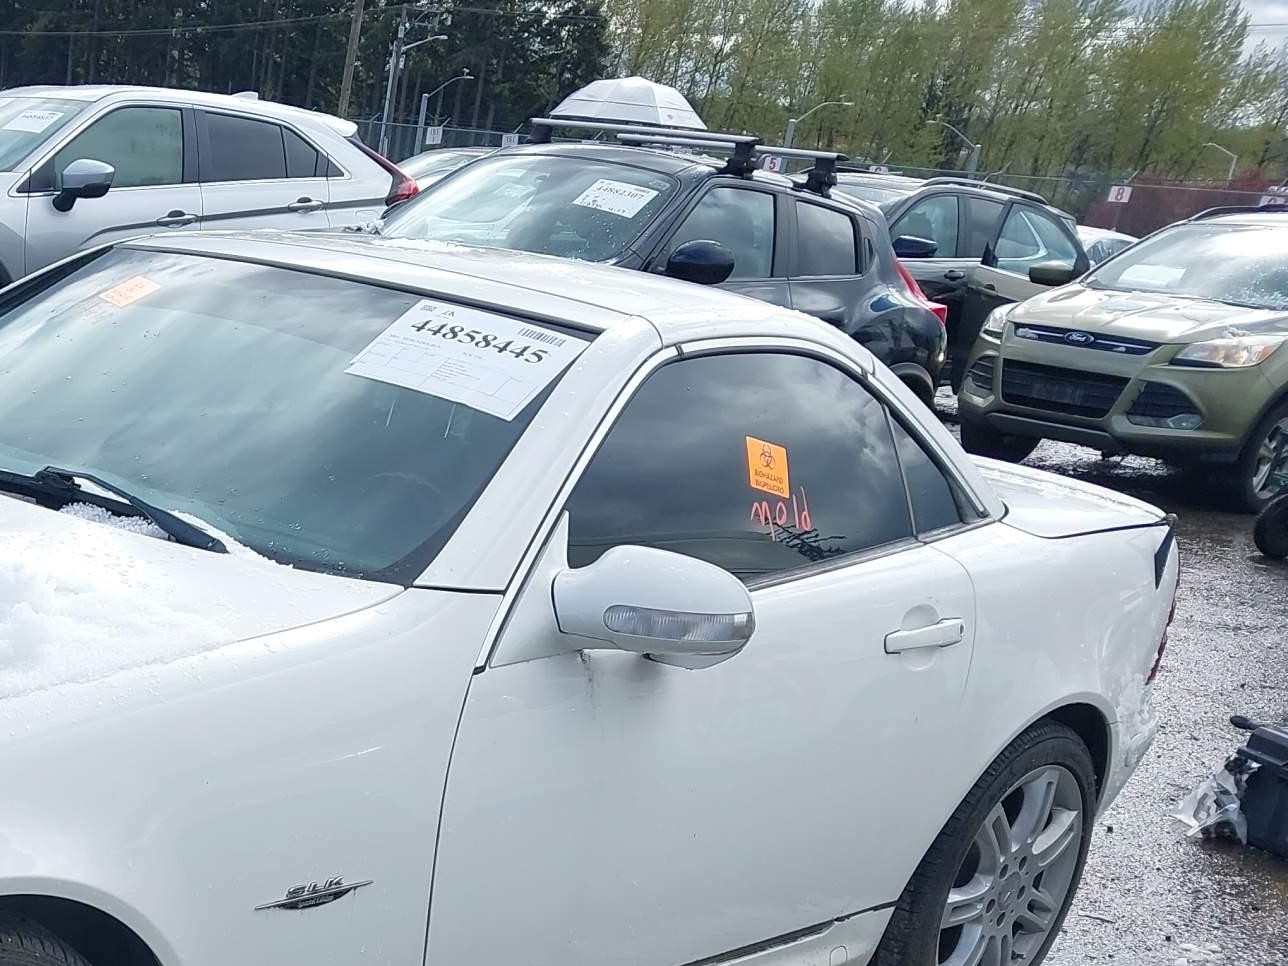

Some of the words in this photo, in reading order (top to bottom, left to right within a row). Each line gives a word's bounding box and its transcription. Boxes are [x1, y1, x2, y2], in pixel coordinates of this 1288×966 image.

[768, 158, 777, 171] 5
[1114, 187, 1125, 202] 8
[410, 319, 549, 364] 44858445
[754, 469, 784, 485] BIOHAZARD
